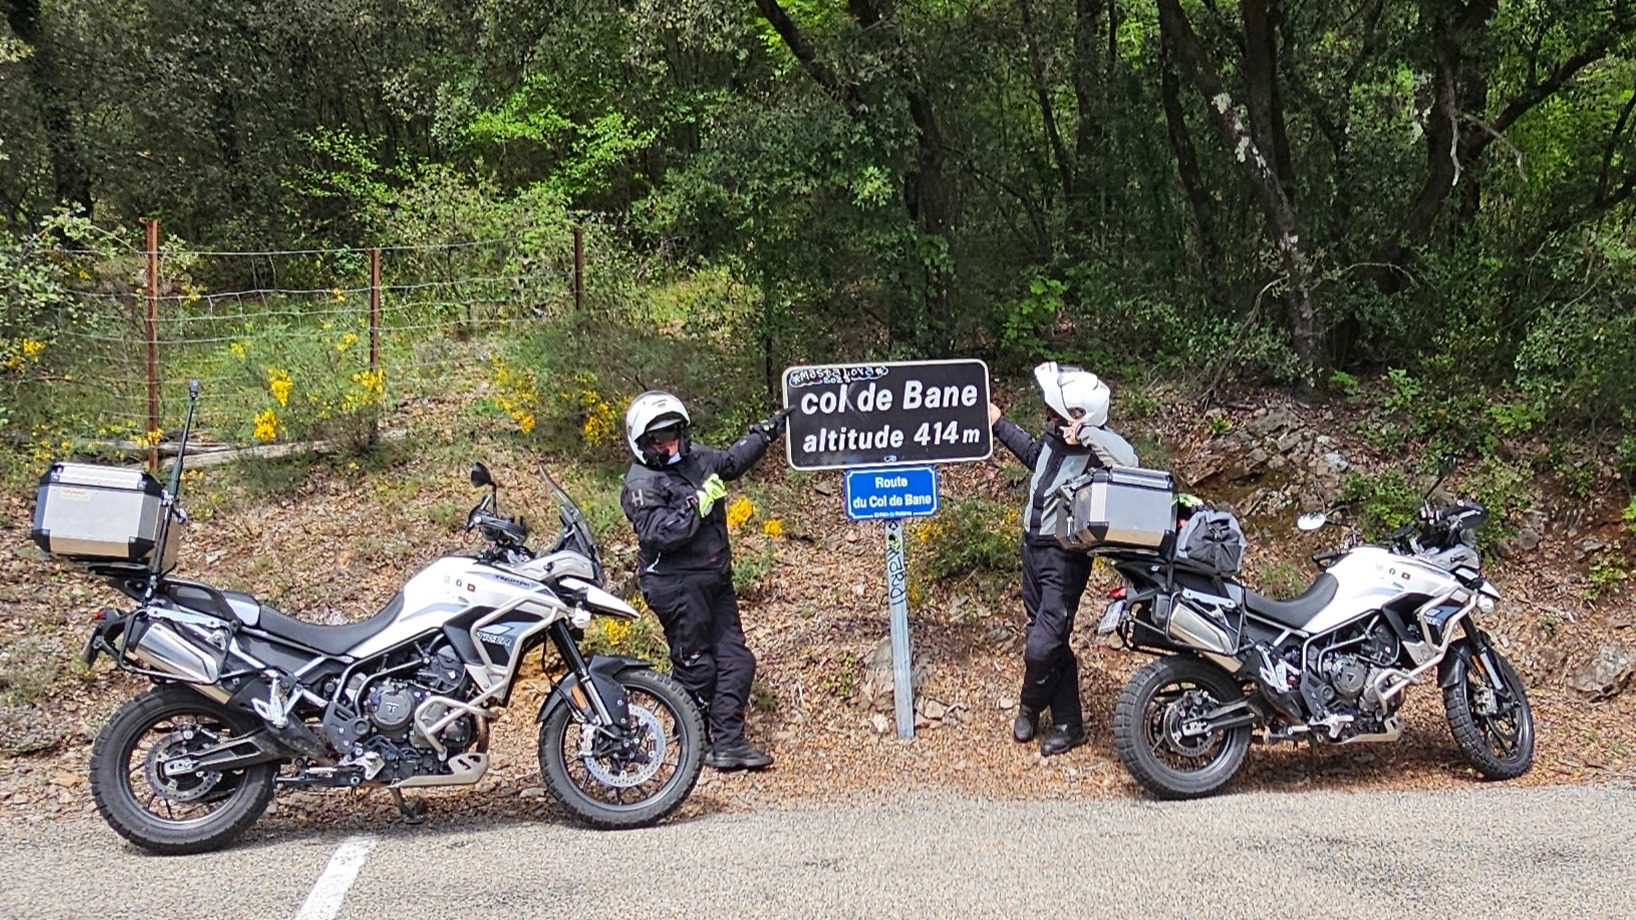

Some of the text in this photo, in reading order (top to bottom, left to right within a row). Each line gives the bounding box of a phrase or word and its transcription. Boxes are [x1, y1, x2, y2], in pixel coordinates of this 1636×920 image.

[801, 380, 978, 415] col de Bane
[803, 420, 980, 452] altitude 414 m
[875, 476, 908, 489] Route
[853, 493, 932, 508] du Col de Bane
